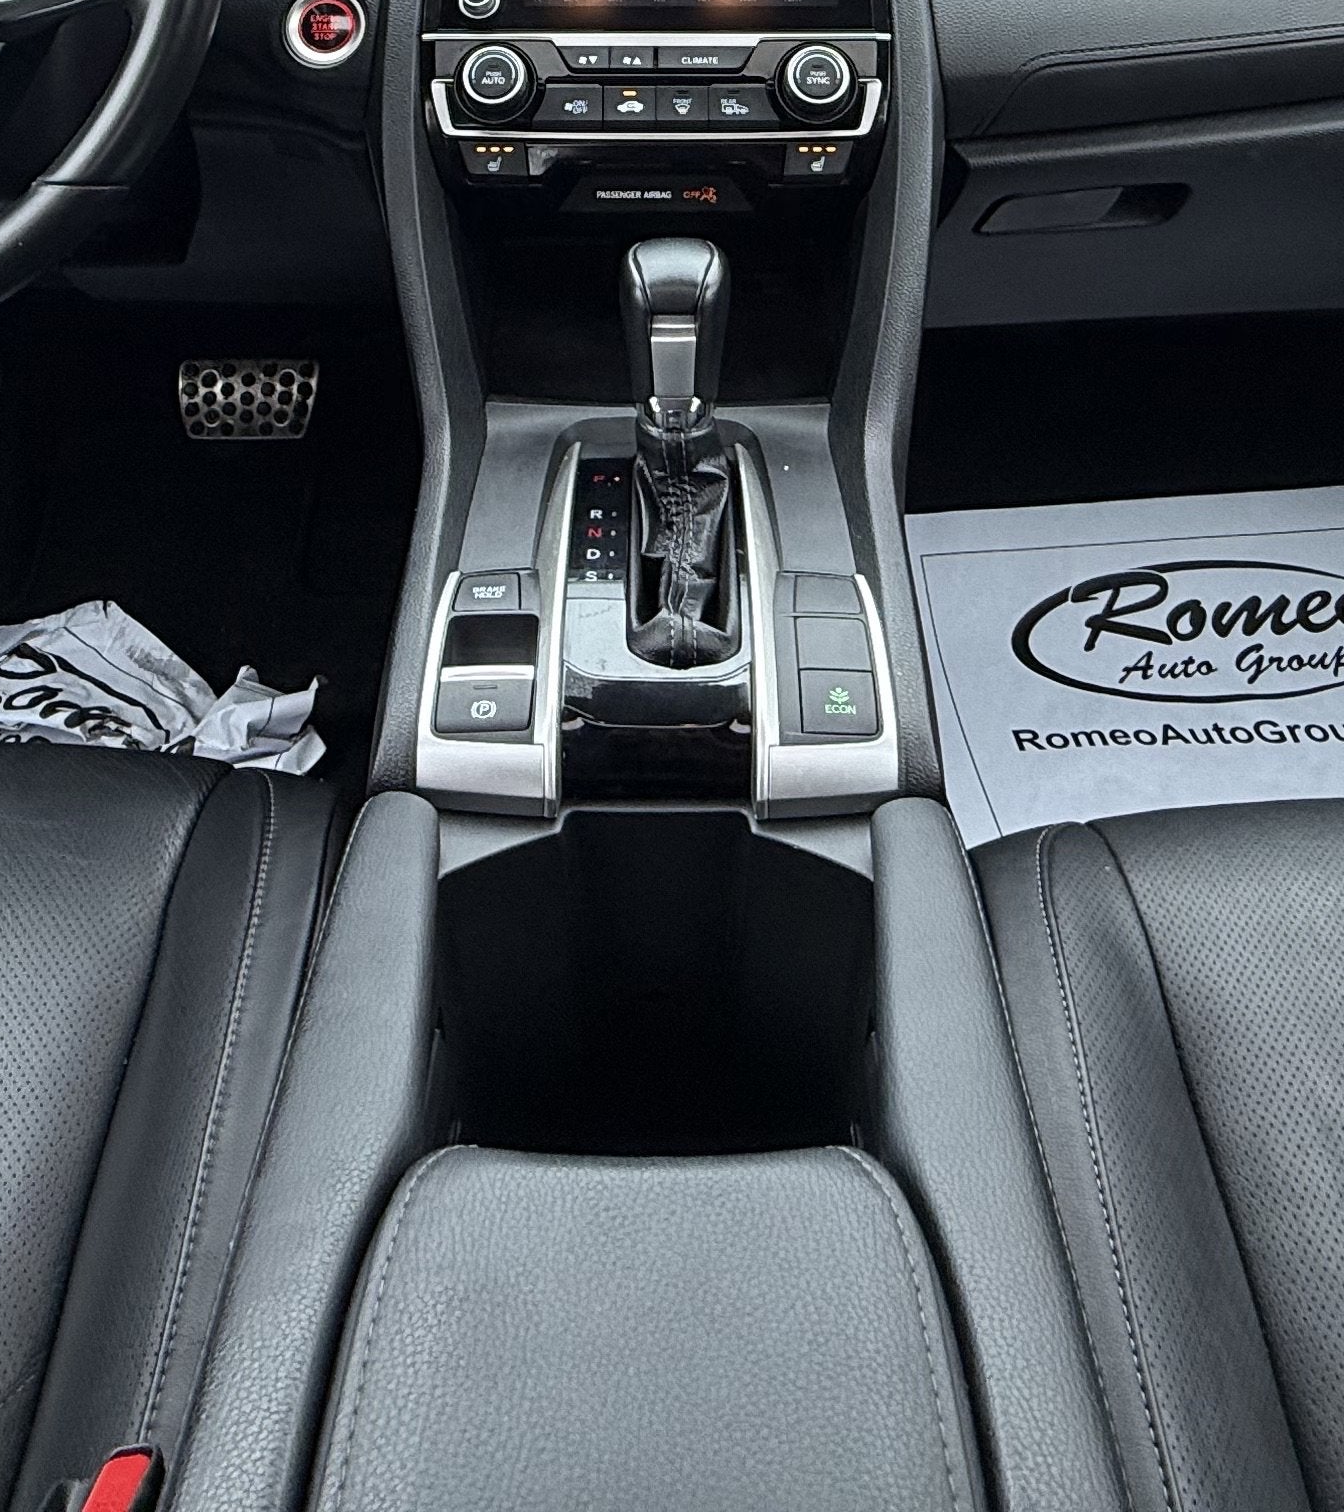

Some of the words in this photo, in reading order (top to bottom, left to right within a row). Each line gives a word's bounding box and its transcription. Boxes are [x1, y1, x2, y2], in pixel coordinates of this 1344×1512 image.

[681, 57, 719, 65] CLIMATE
[481, 76, 506, 85] AUTO
[806, 76, 831, 85] SYNC
[596, 190, 642, 199] PASSENGER
[643, 190, 672, 199] AIRBAG
[590, 509, 603, 519] R
[587, 528, 603, 537] N
[586, 548, 601, 560] D
[585, 571, 598, 582] S
[472, 585, 506, 593] BRAKE
[1118, 651, 1219, 685] Auto
[825, 704, 857, 715] ECON
